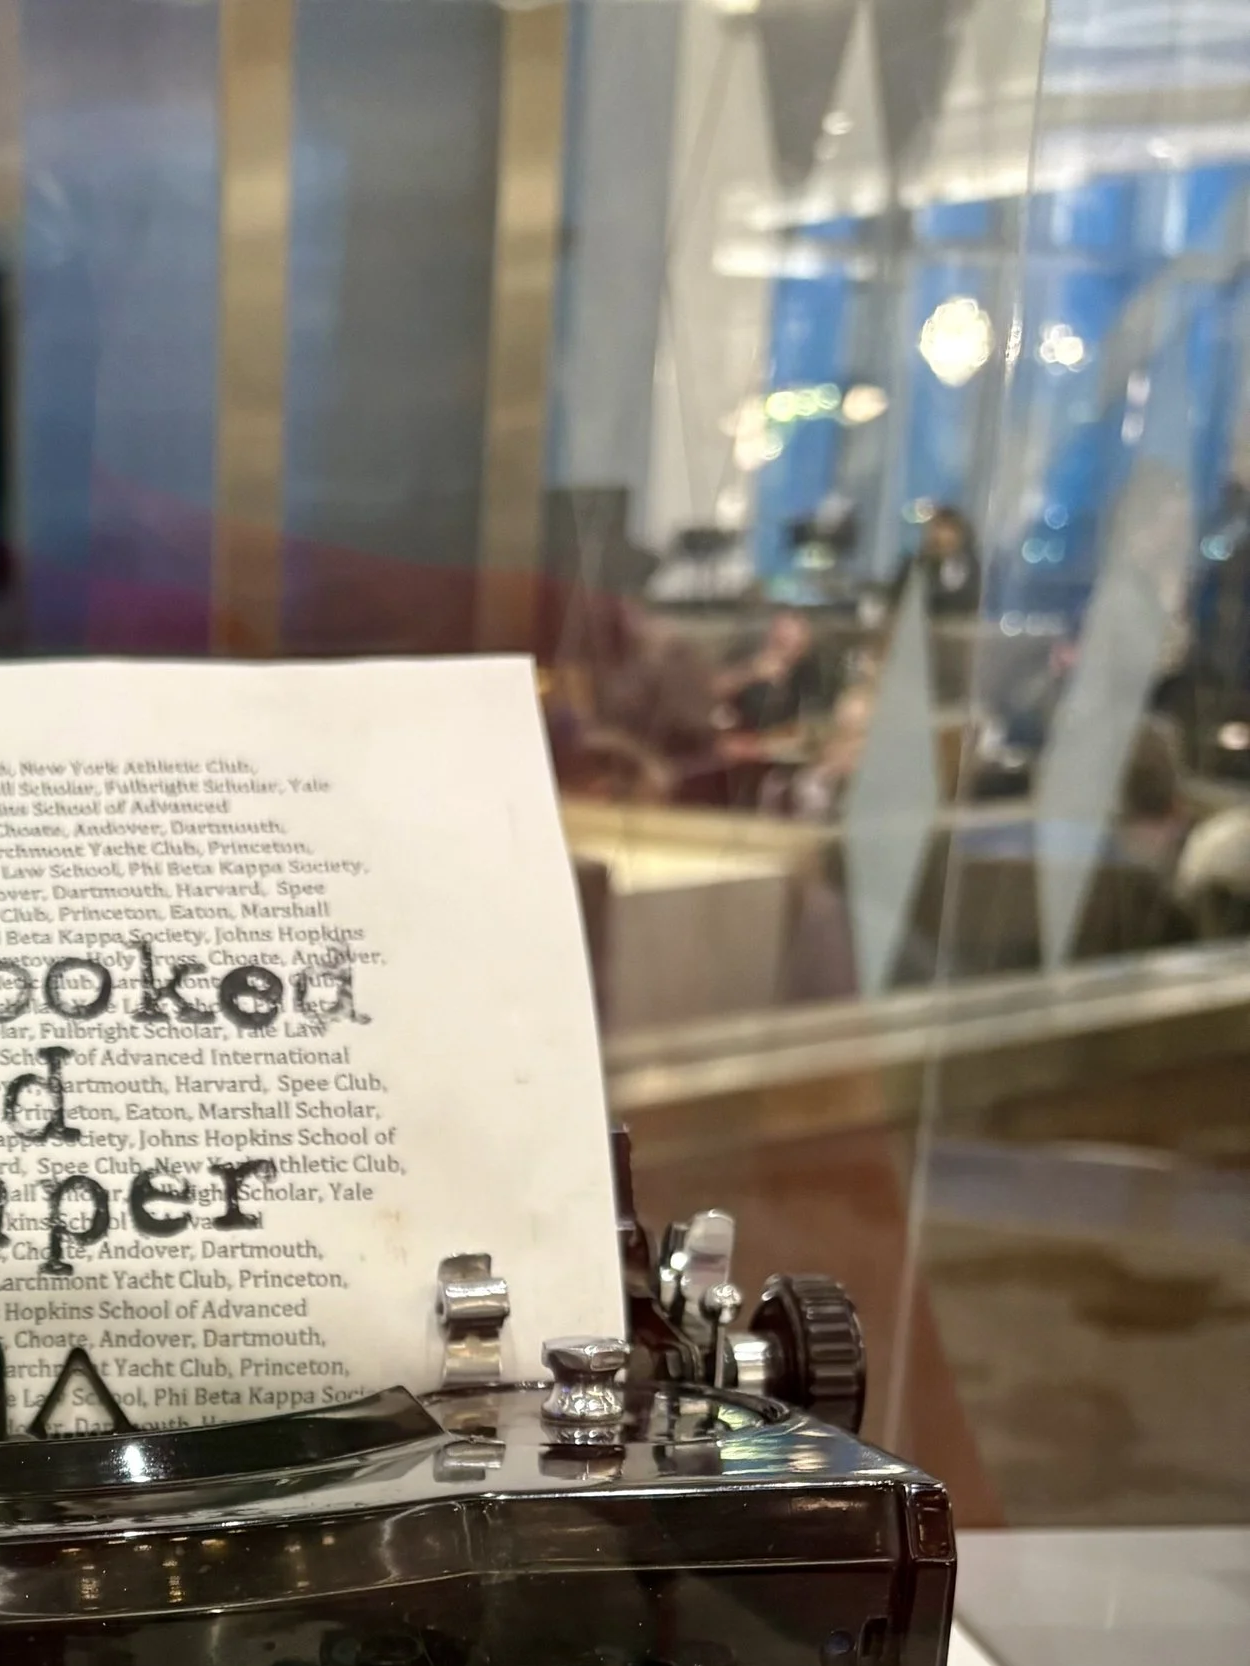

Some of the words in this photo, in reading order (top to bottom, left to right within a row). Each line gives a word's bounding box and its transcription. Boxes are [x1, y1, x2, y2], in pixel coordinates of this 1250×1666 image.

[40, 1021, 140, 1043] Fulbright
[144, 1022, 229, 1041] Scholar,
[285, 1022, 327, 1038] Law
[75, 1047, 97, 1066] of
[101, 1047, 205, 1066] Advanced
[211, 1045, 351, 1065] International
[12, 1242, 94, 1262] Chote,
[100, 1241, 196, 1260] Andover,
[201, 1240, 324, 1260] Dartmouth,
[113, 1270, 176, 1289] Yacht
[179, 1269, 234, 1290] Club,
[239, 1270, 348, 1290] Princeton,
[5, 1301, 93, 1325] Hopkins
[98, 1301, 169, 1320] School
[175, 1299, 199, 1319] of
[202, 1299, 308, 1319] Advanced
